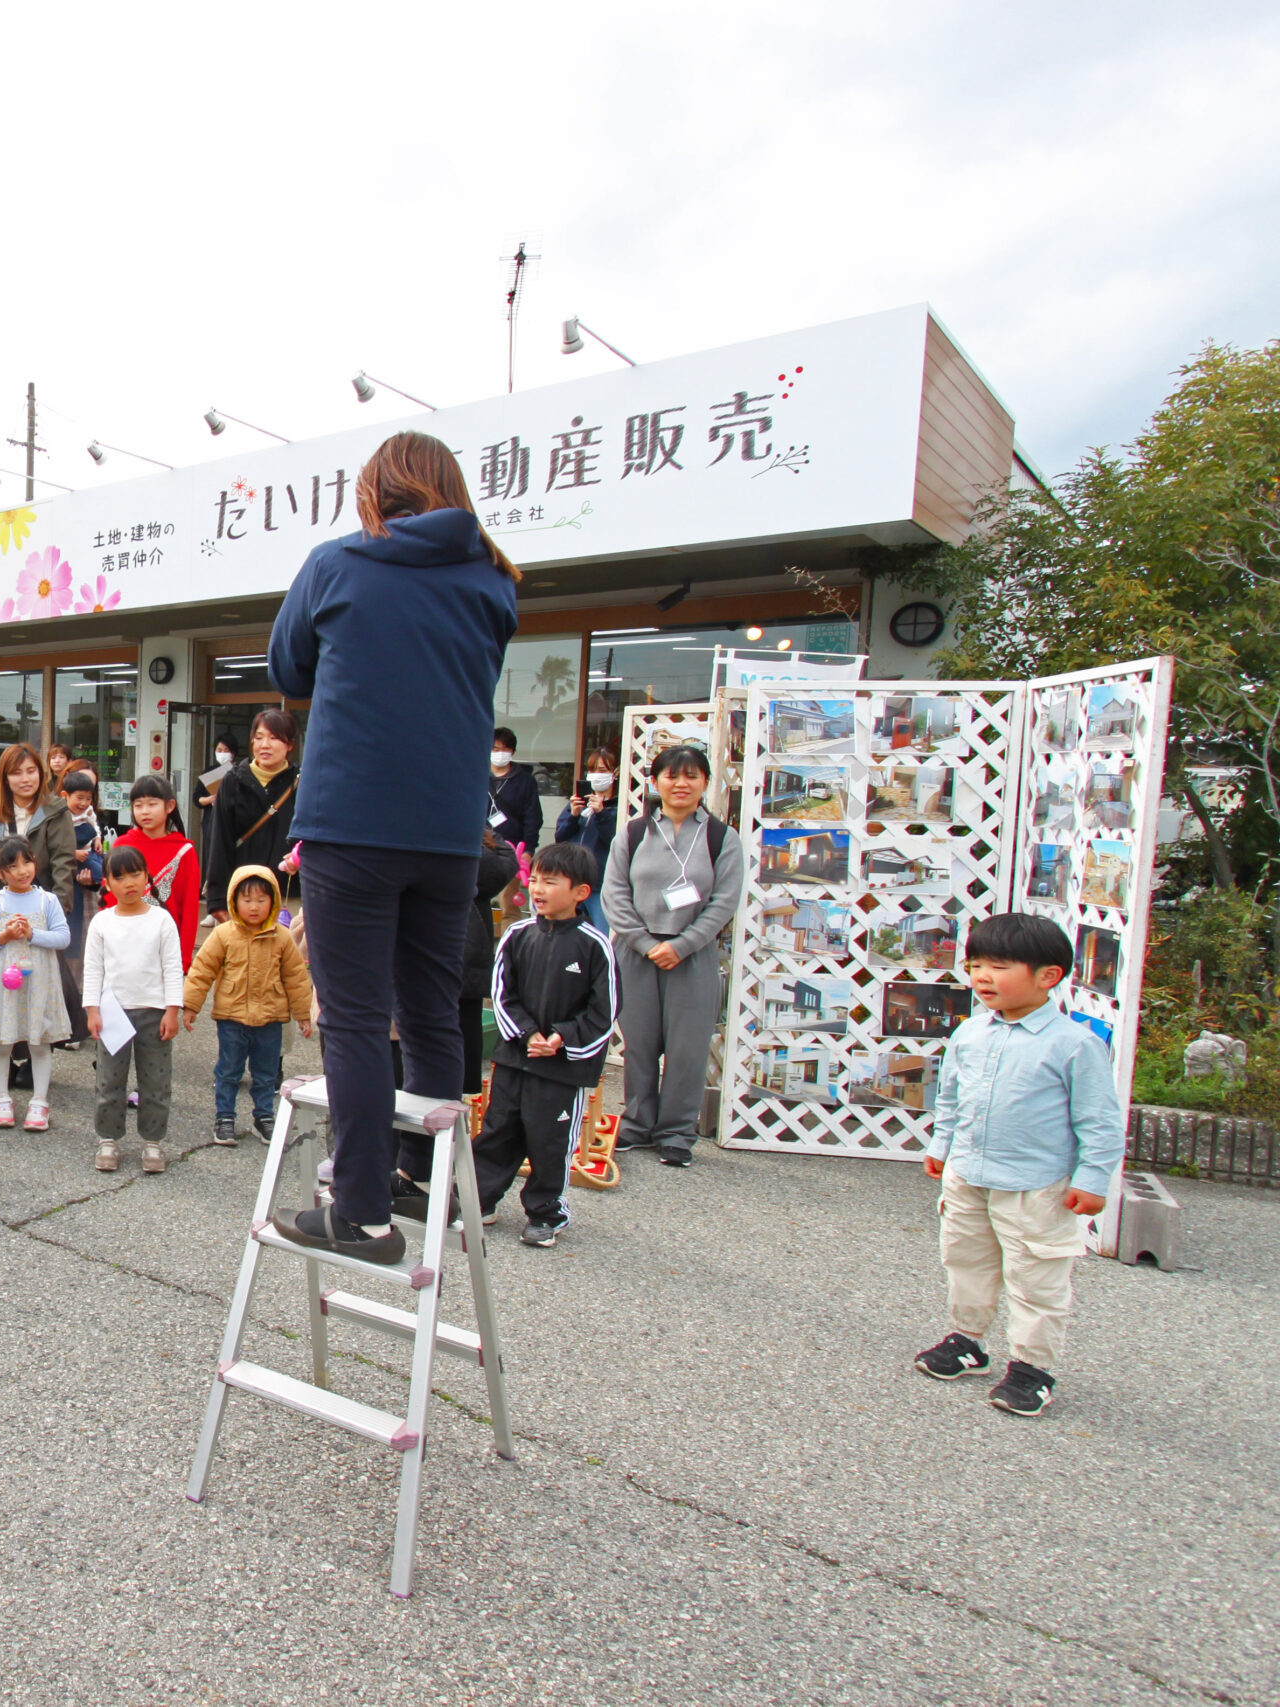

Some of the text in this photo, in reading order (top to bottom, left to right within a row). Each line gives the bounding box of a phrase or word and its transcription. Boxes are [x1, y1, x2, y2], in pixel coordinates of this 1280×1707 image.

[93, 521, 175, 548] 土地・建物の
[101, 547, 164, 572] 売買仲介
